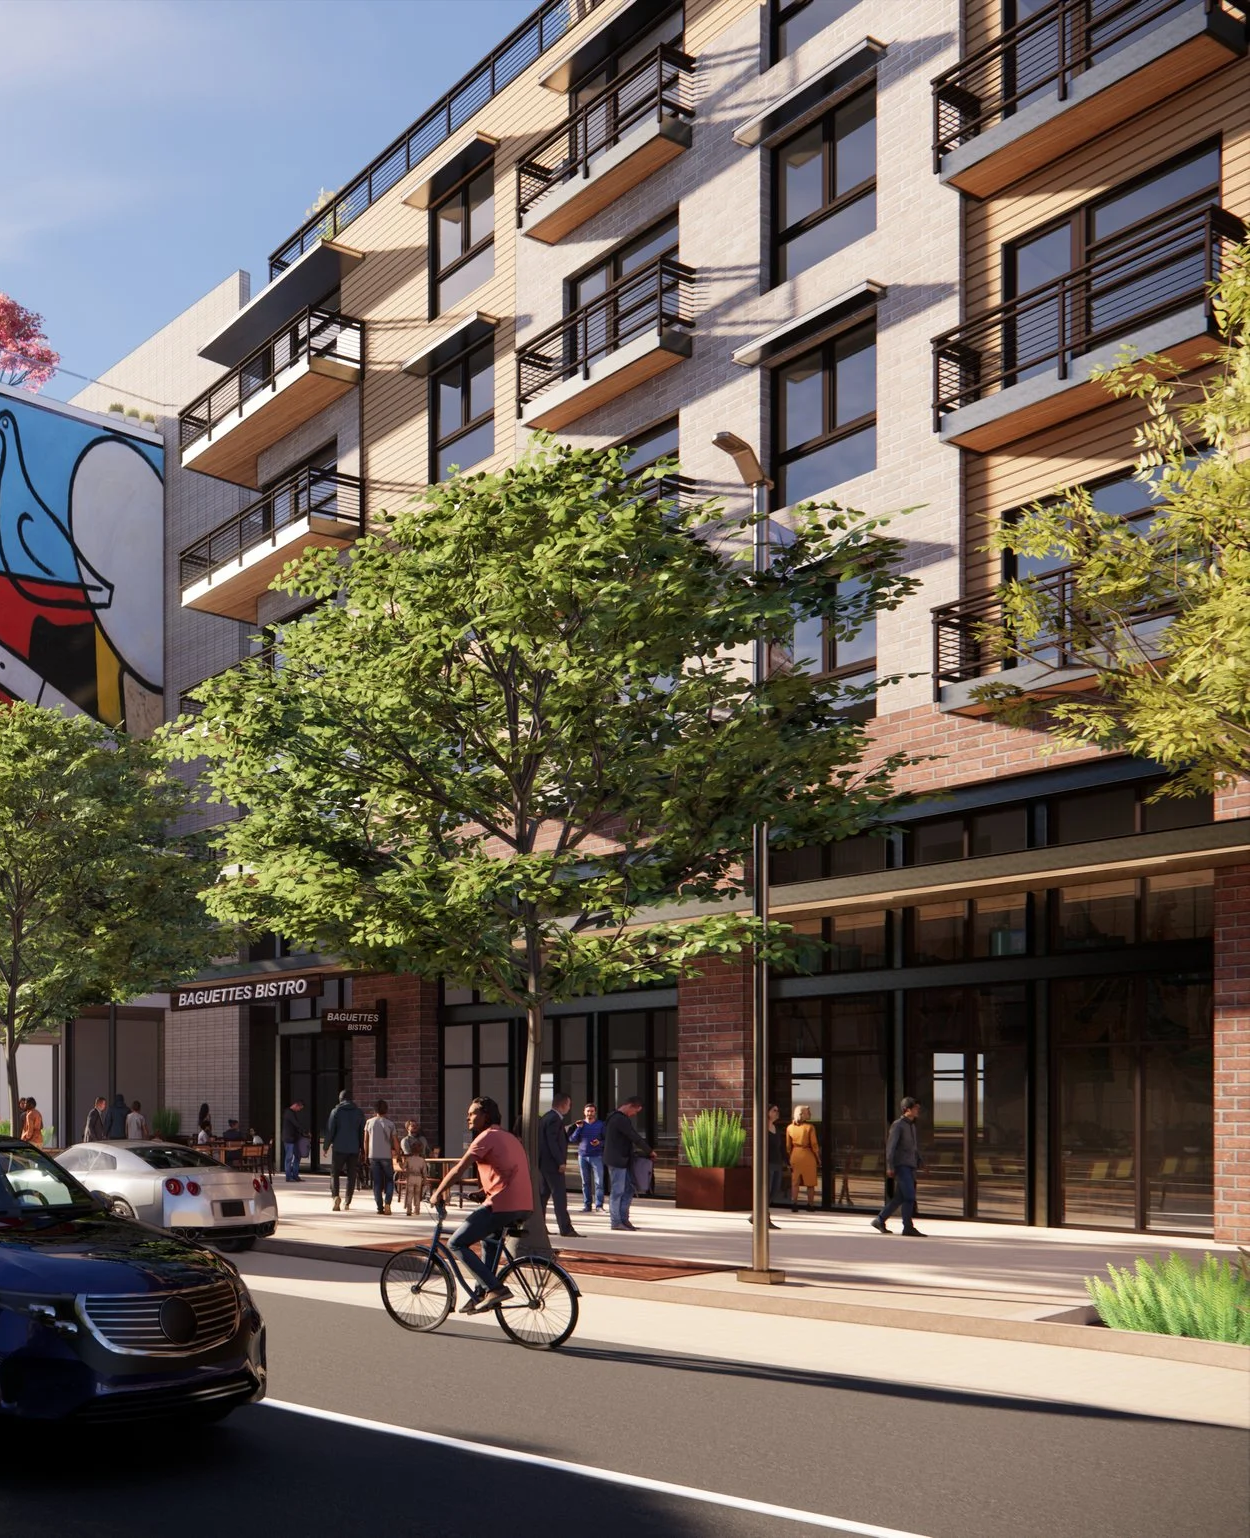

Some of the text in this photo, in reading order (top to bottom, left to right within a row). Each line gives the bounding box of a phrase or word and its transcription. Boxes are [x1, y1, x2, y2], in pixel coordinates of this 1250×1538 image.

[178, 979, 307, 1007] BAGUETTES BISTRO
[327, 1012, 379, 1022] BAGUETTES
